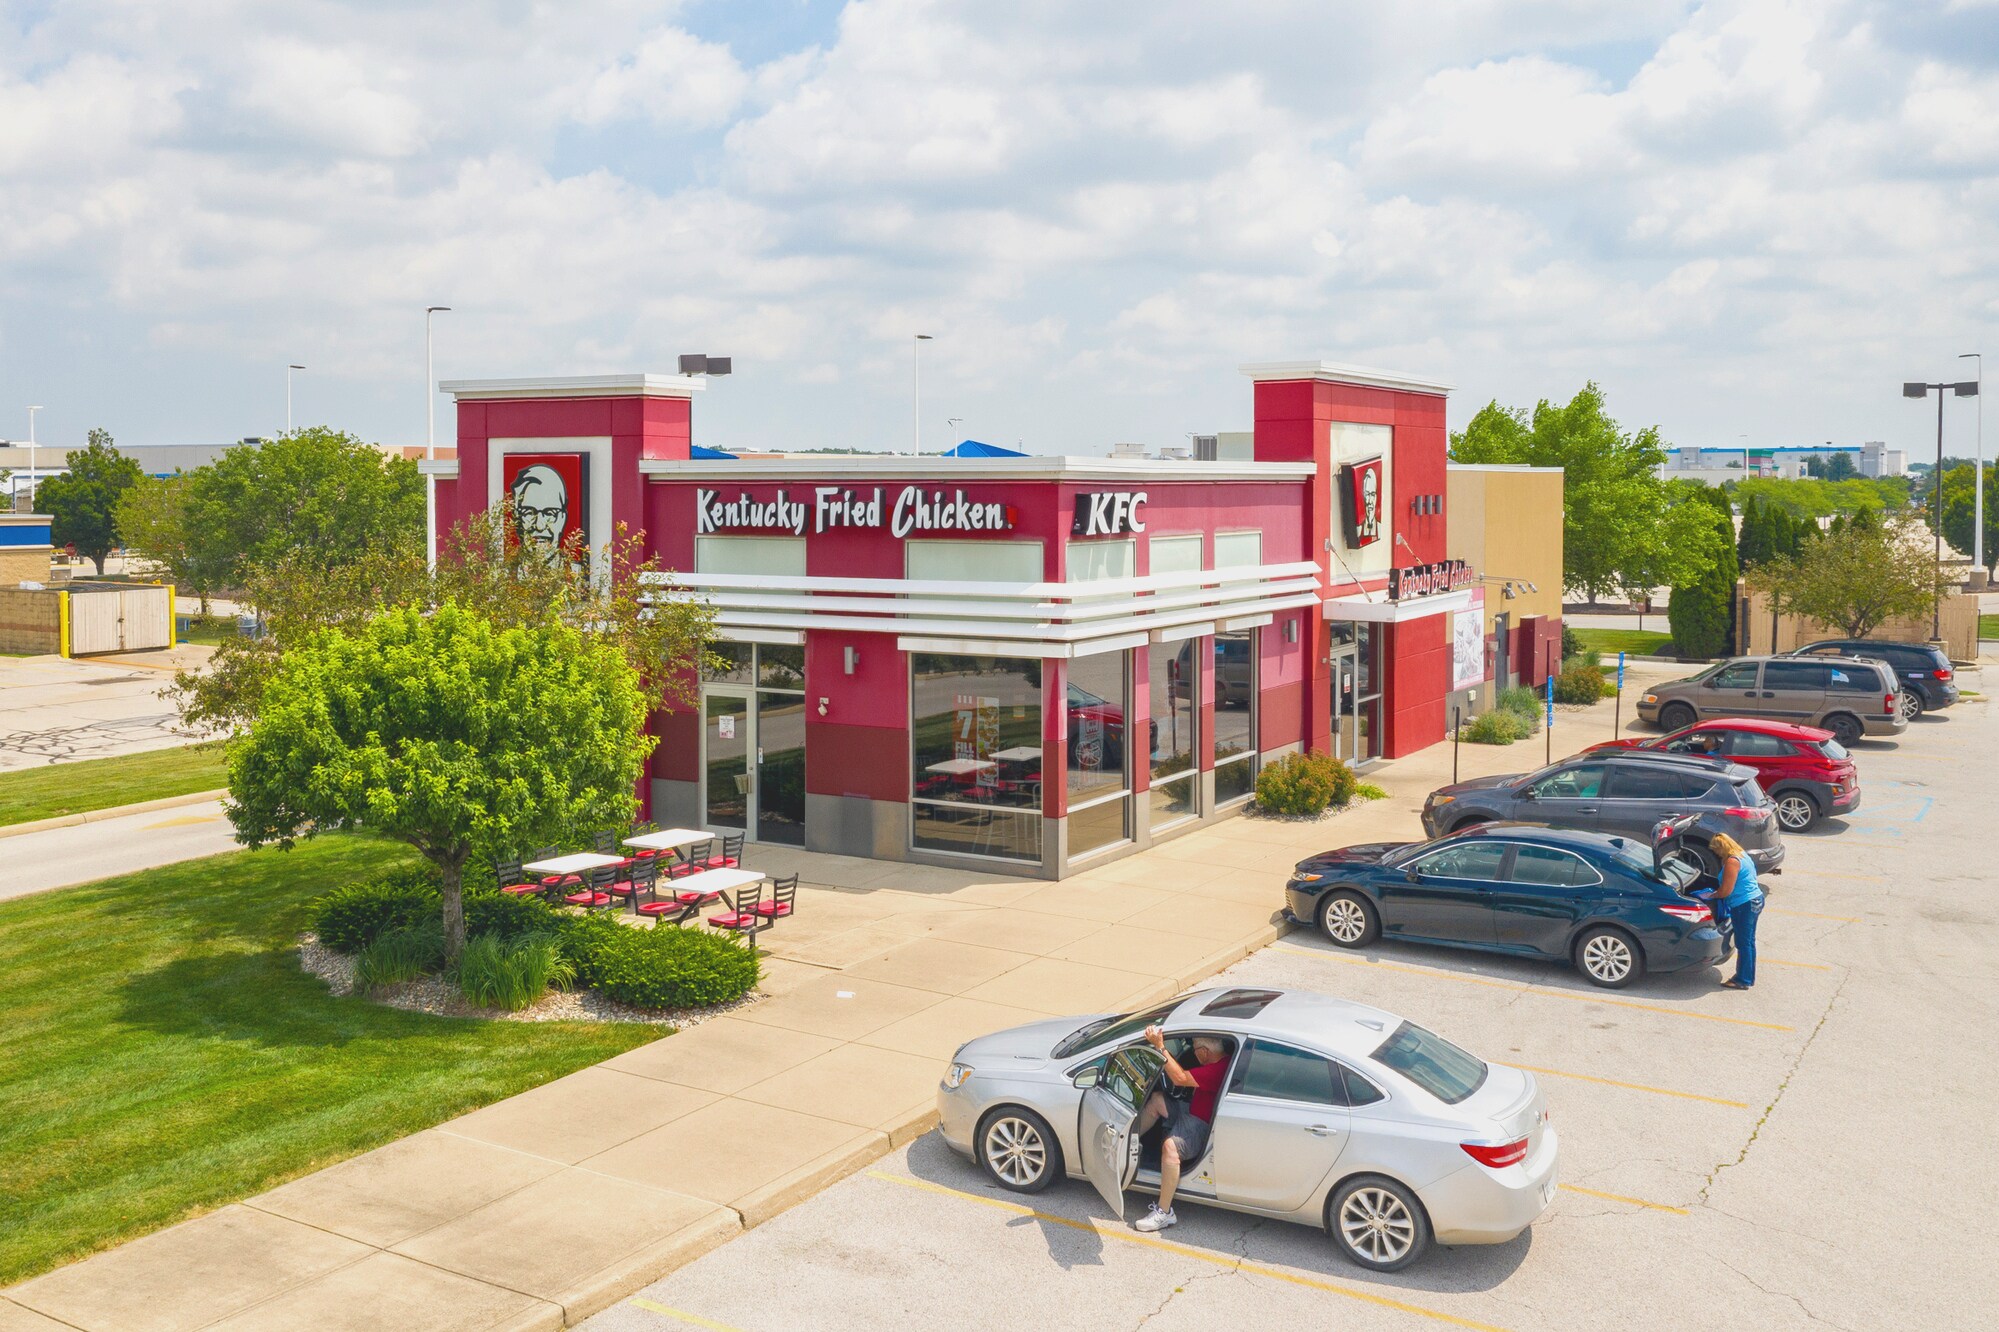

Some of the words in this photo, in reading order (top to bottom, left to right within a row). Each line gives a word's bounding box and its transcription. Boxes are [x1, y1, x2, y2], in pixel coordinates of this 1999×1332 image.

[697, 488, 805, 535] Kentucky
[815, 487, 880, 534] Fried
[891, 485, 1003, 538] Chicken
[1086, 492, 1148, 536] KFC
[957, 710, 973, 739] 7
[955, 741, 974, 754] FILL
